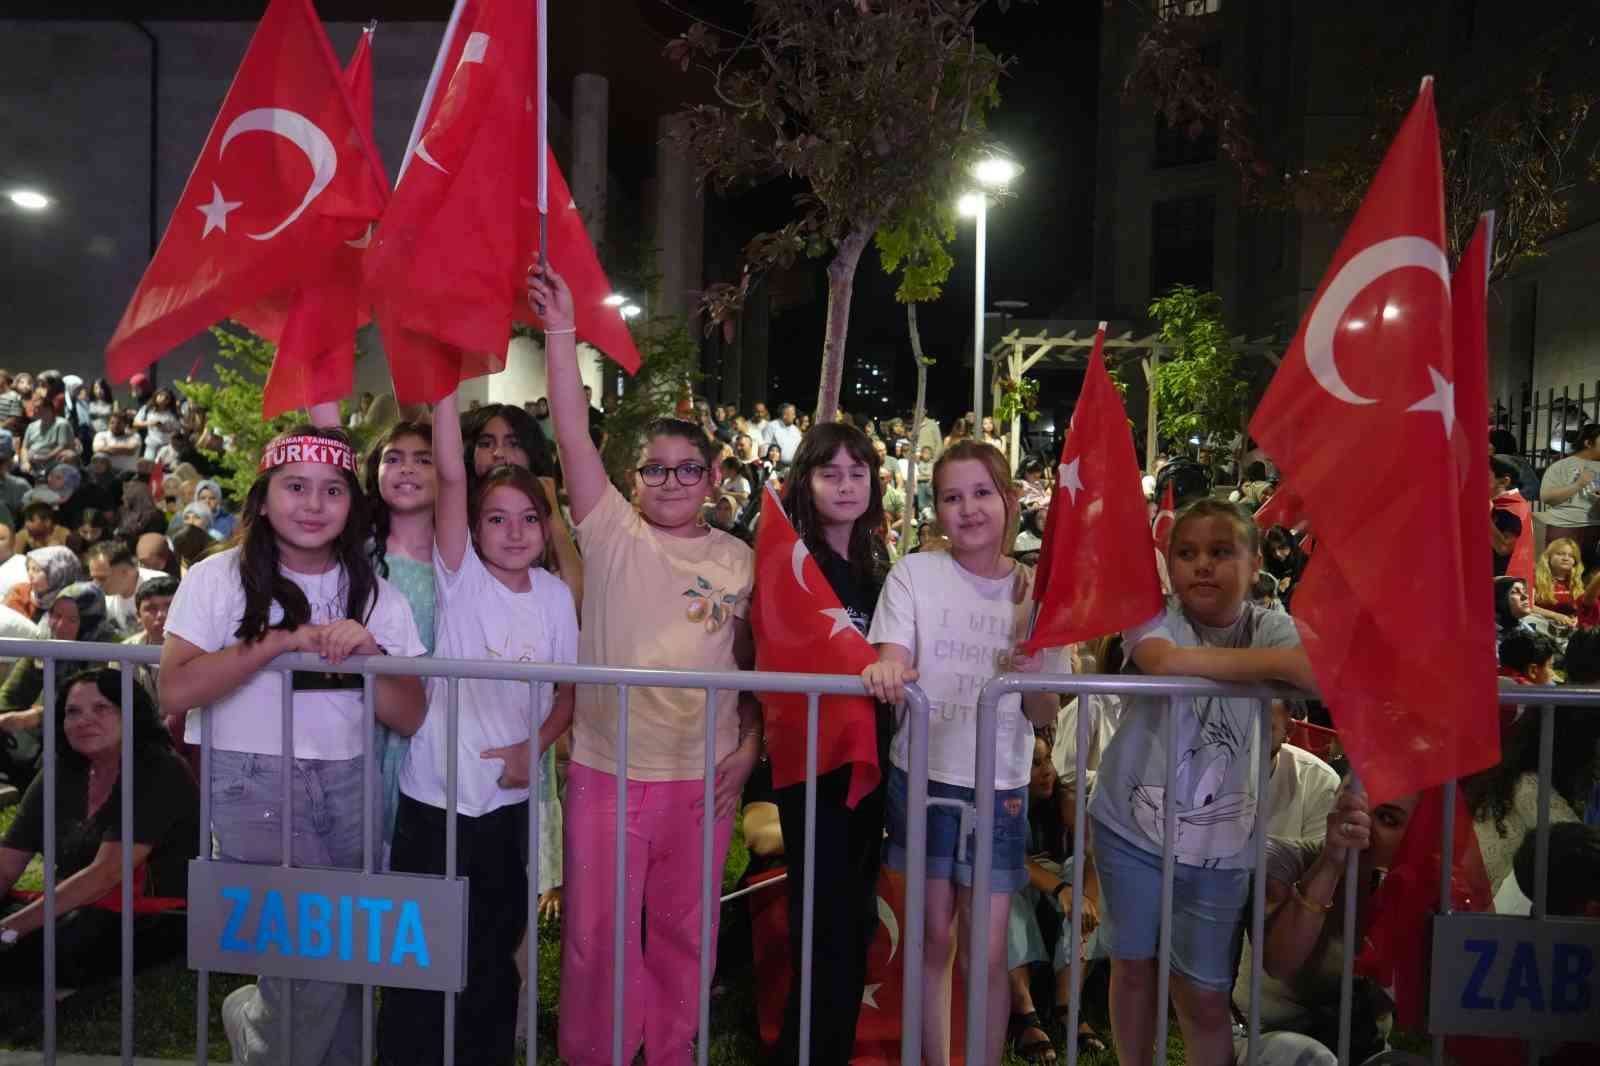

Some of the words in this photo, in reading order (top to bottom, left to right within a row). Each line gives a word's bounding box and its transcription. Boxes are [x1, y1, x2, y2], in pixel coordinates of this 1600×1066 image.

[954, 673, 986, 697] TH
[219, 886, 431, 968] ZABITA
[1461, 938, 1593, 1012] ZAB
